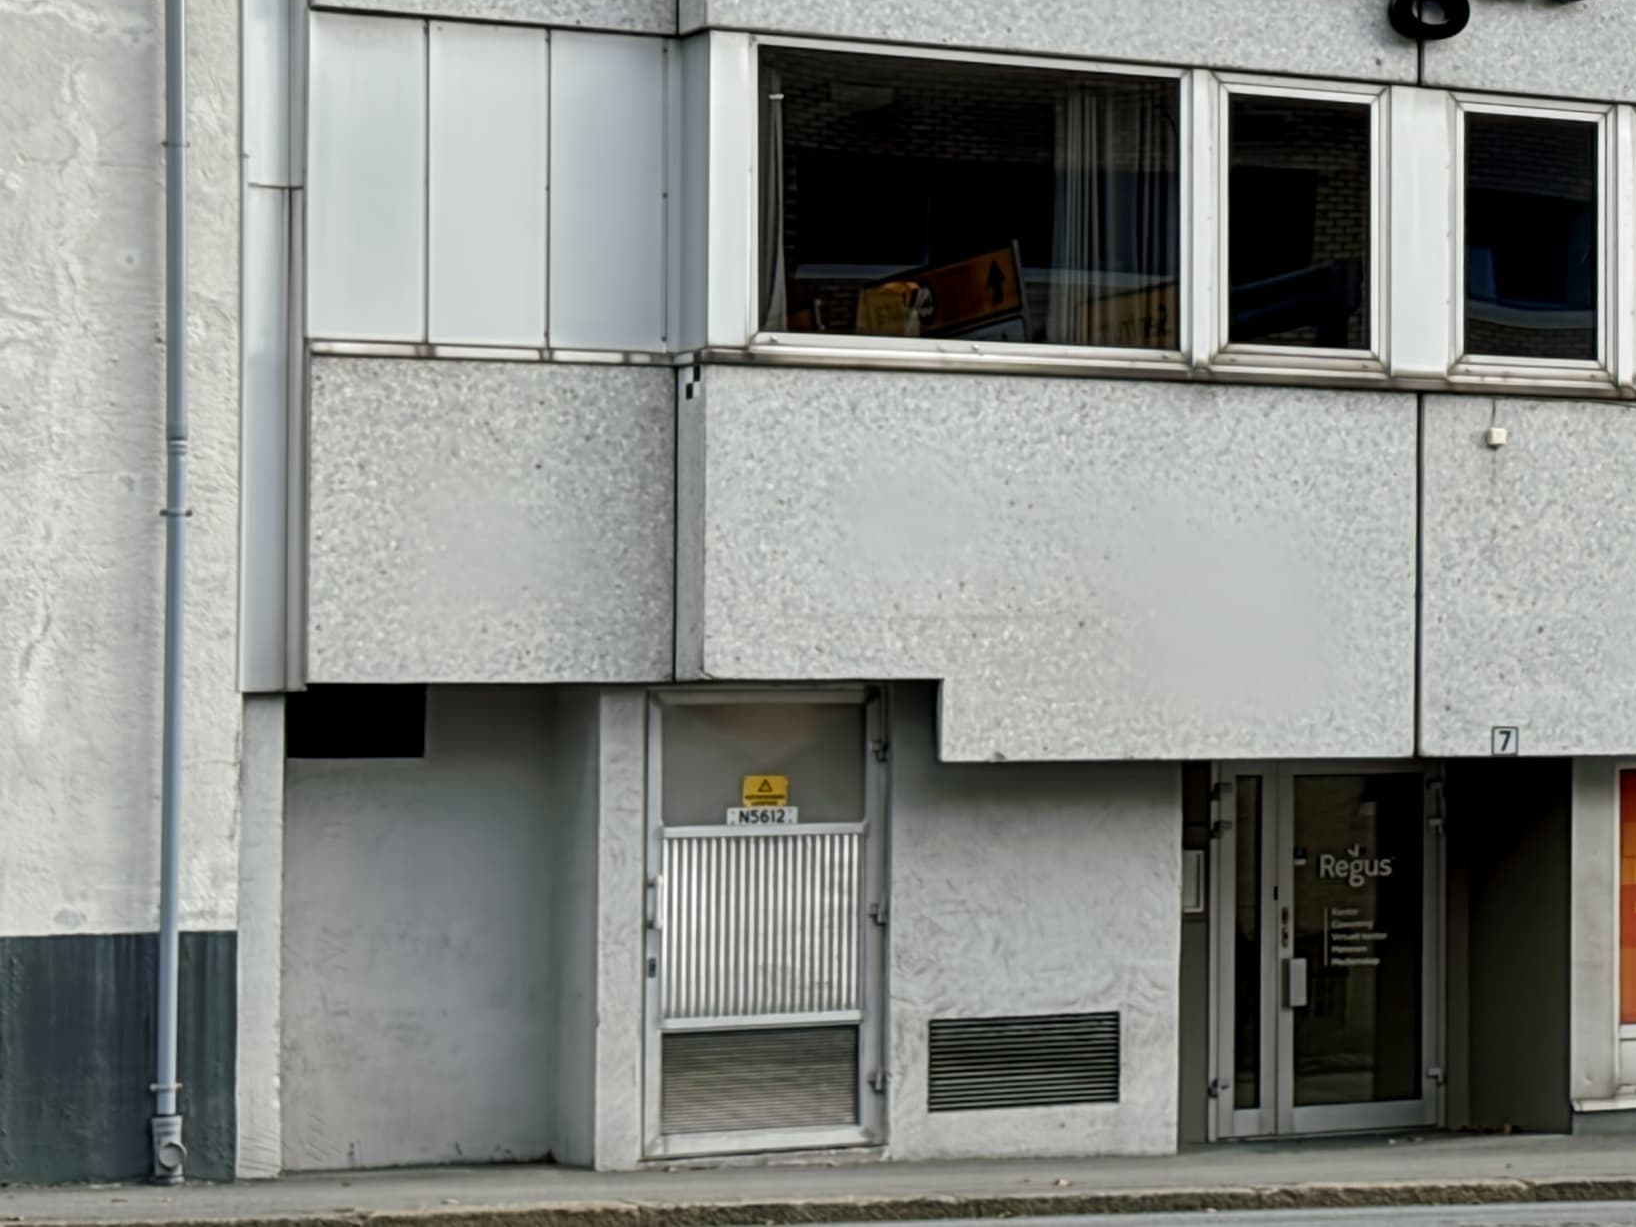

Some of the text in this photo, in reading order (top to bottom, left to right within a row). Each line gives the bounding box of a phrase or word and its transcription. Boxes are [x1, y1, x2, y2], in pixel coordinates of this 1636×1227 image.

[1499, 729, 1512, 752] 7
[739, 808, 785, 824] N5612
[1319, 852, 1393, 888] Regus
